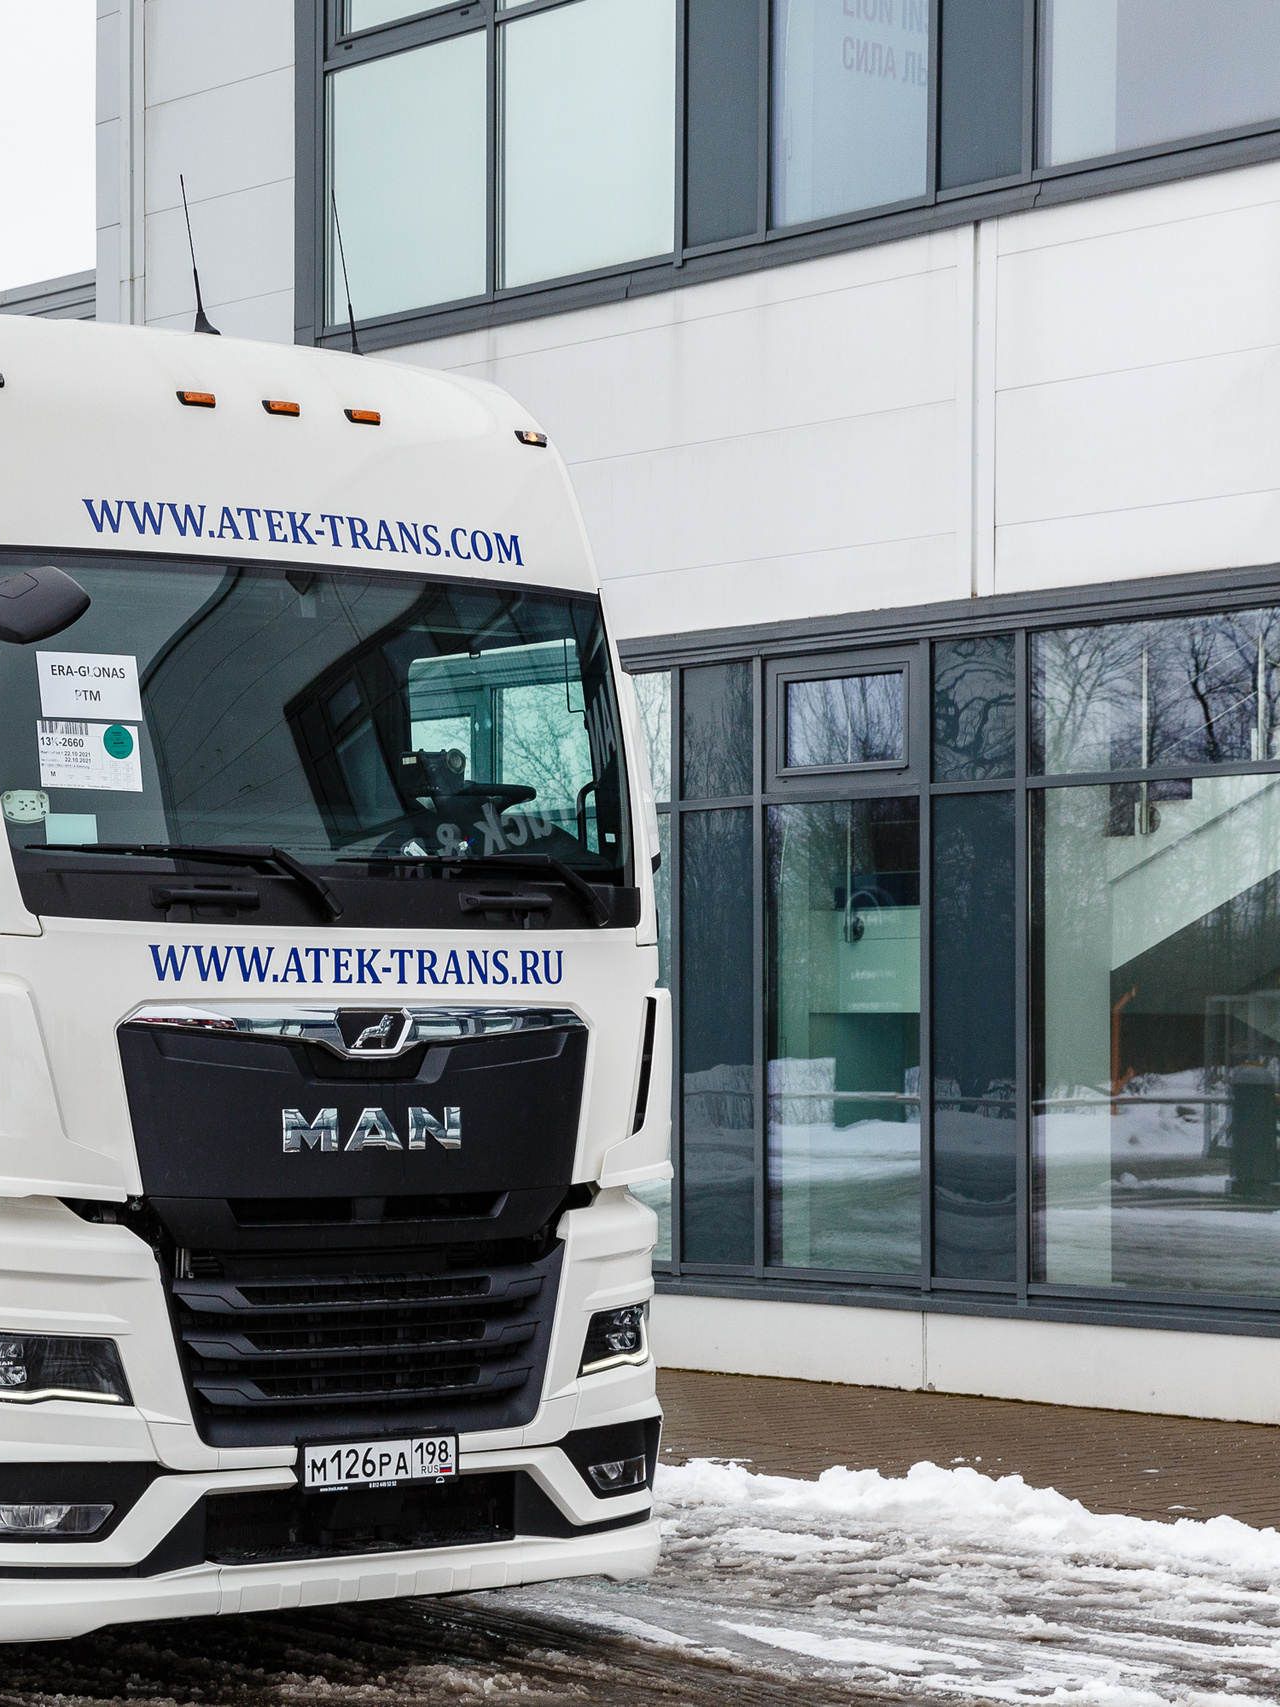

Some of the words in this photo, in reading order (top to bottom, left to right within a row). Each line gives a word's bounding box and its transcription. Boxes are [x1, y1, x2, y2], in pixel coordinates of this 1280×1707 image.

[842, 35, 897, 80] СИЛА
[81, 498, 525, 567] WWW.ATEK-TRANS.COM
[148, 943, 564, 985] WWW.ATEK-TRANS.RU
[281, 1106, 462, 1153] MAN
[414, 1440, 449, 1465] 198
[421, 1464, 439, 1475] RUS
